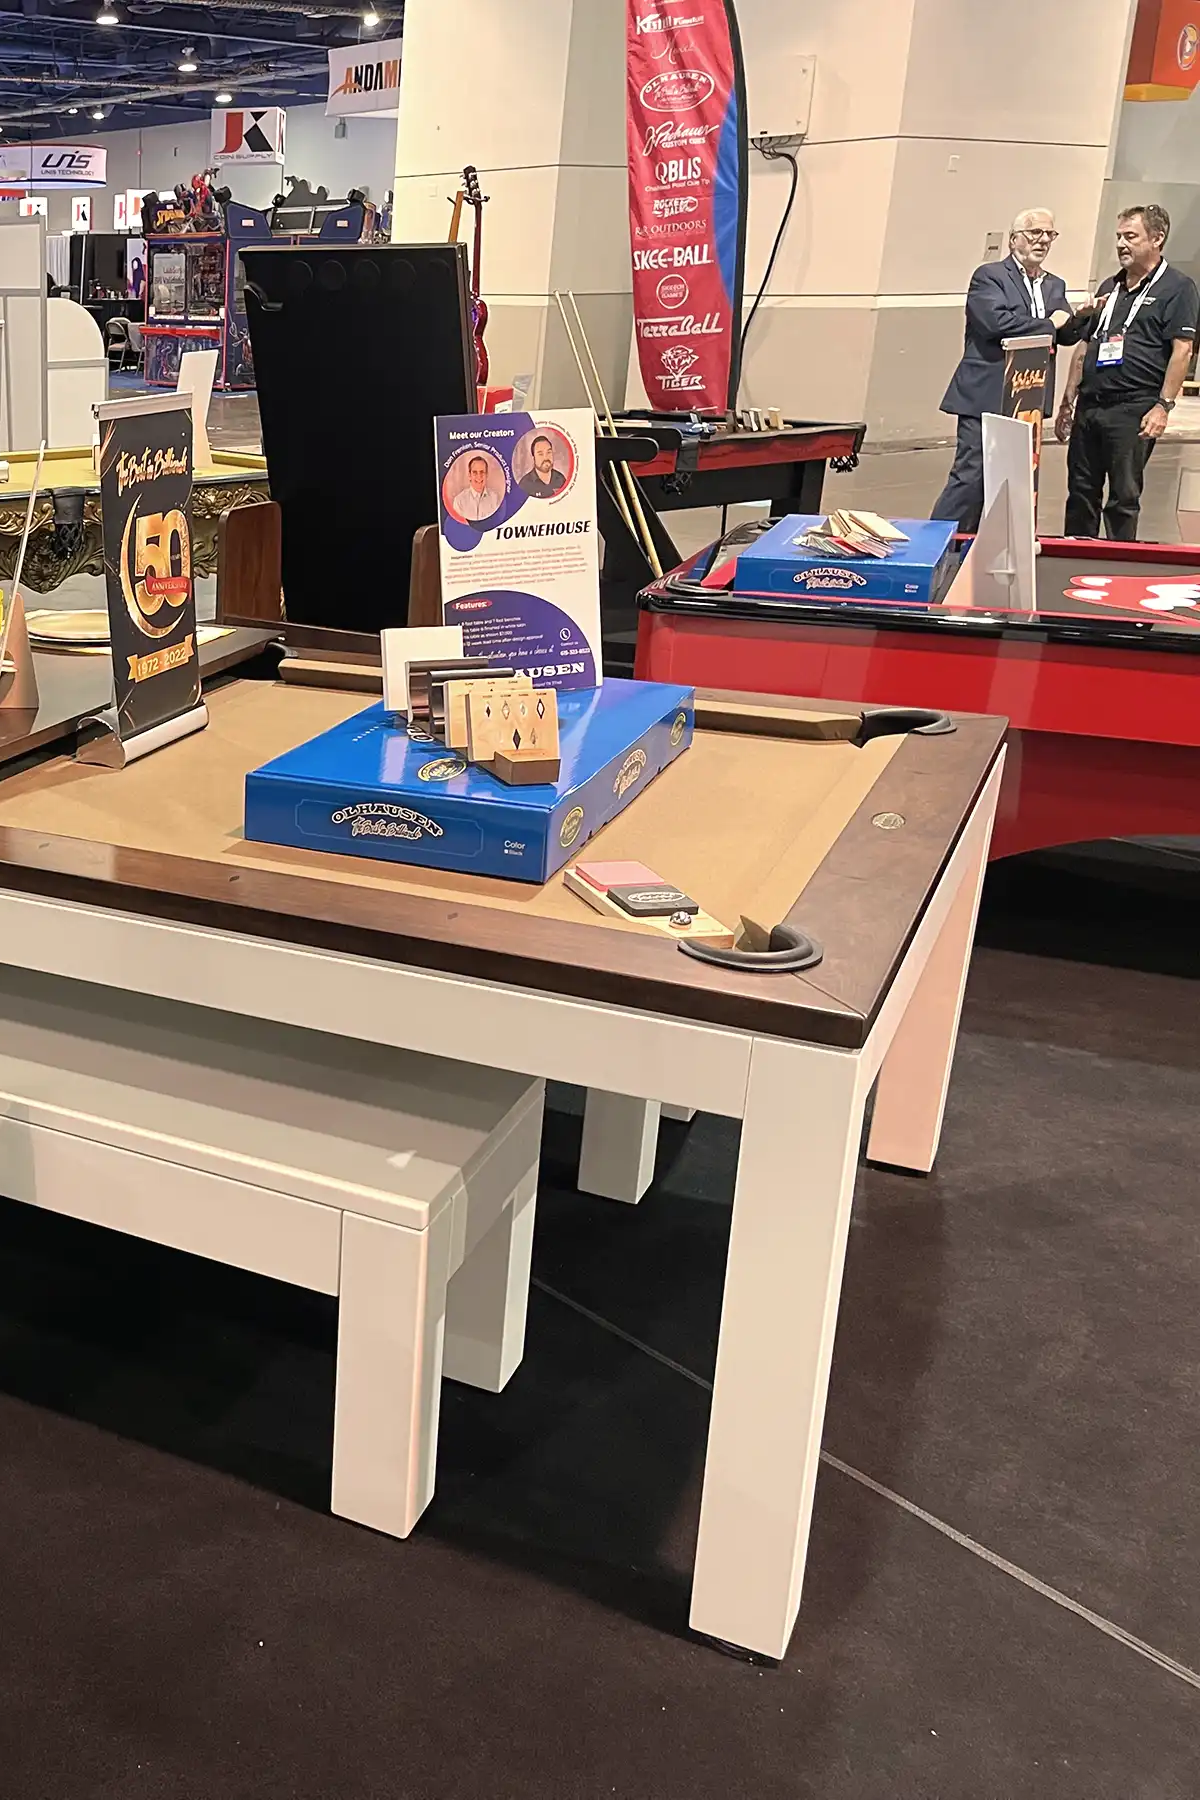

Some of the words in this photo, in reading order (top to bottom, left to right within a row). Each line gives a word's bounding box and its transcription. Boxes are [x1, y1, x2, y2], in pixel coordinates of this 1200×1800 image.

[645, 73, 709, 93] OLHAUSEN
[216, 111, 274, 154] JK
[662, 138, 688, 149] CUSTOM
[235, 152, 273, 160] SUPPLY
[58, 169, 95, 177] TECHNOLOGY
[655, 156, 702, 185] QBLIS
[650, 220, 707, 234] OUTDOORS
[633, 244, 712, 270] SKEE-BALL
[637, 312, 724, 338] TerraBall
[655, 376, 704, 391] TIGER
[449, 431, 469, 440] Meet
[483, 429, 515, 438] Creators
[495, 520, 591, 541] TOWNEHOUSE
[134, 508, 192, 616] 50
[455, 601, 488, 610] Features:
[137, 657, 159, 677] 1972
[163, 647, 186, 666] 2022
[332, 803, 444, 838] OLHAUSEN
[504, 840, 526, 850] Color
